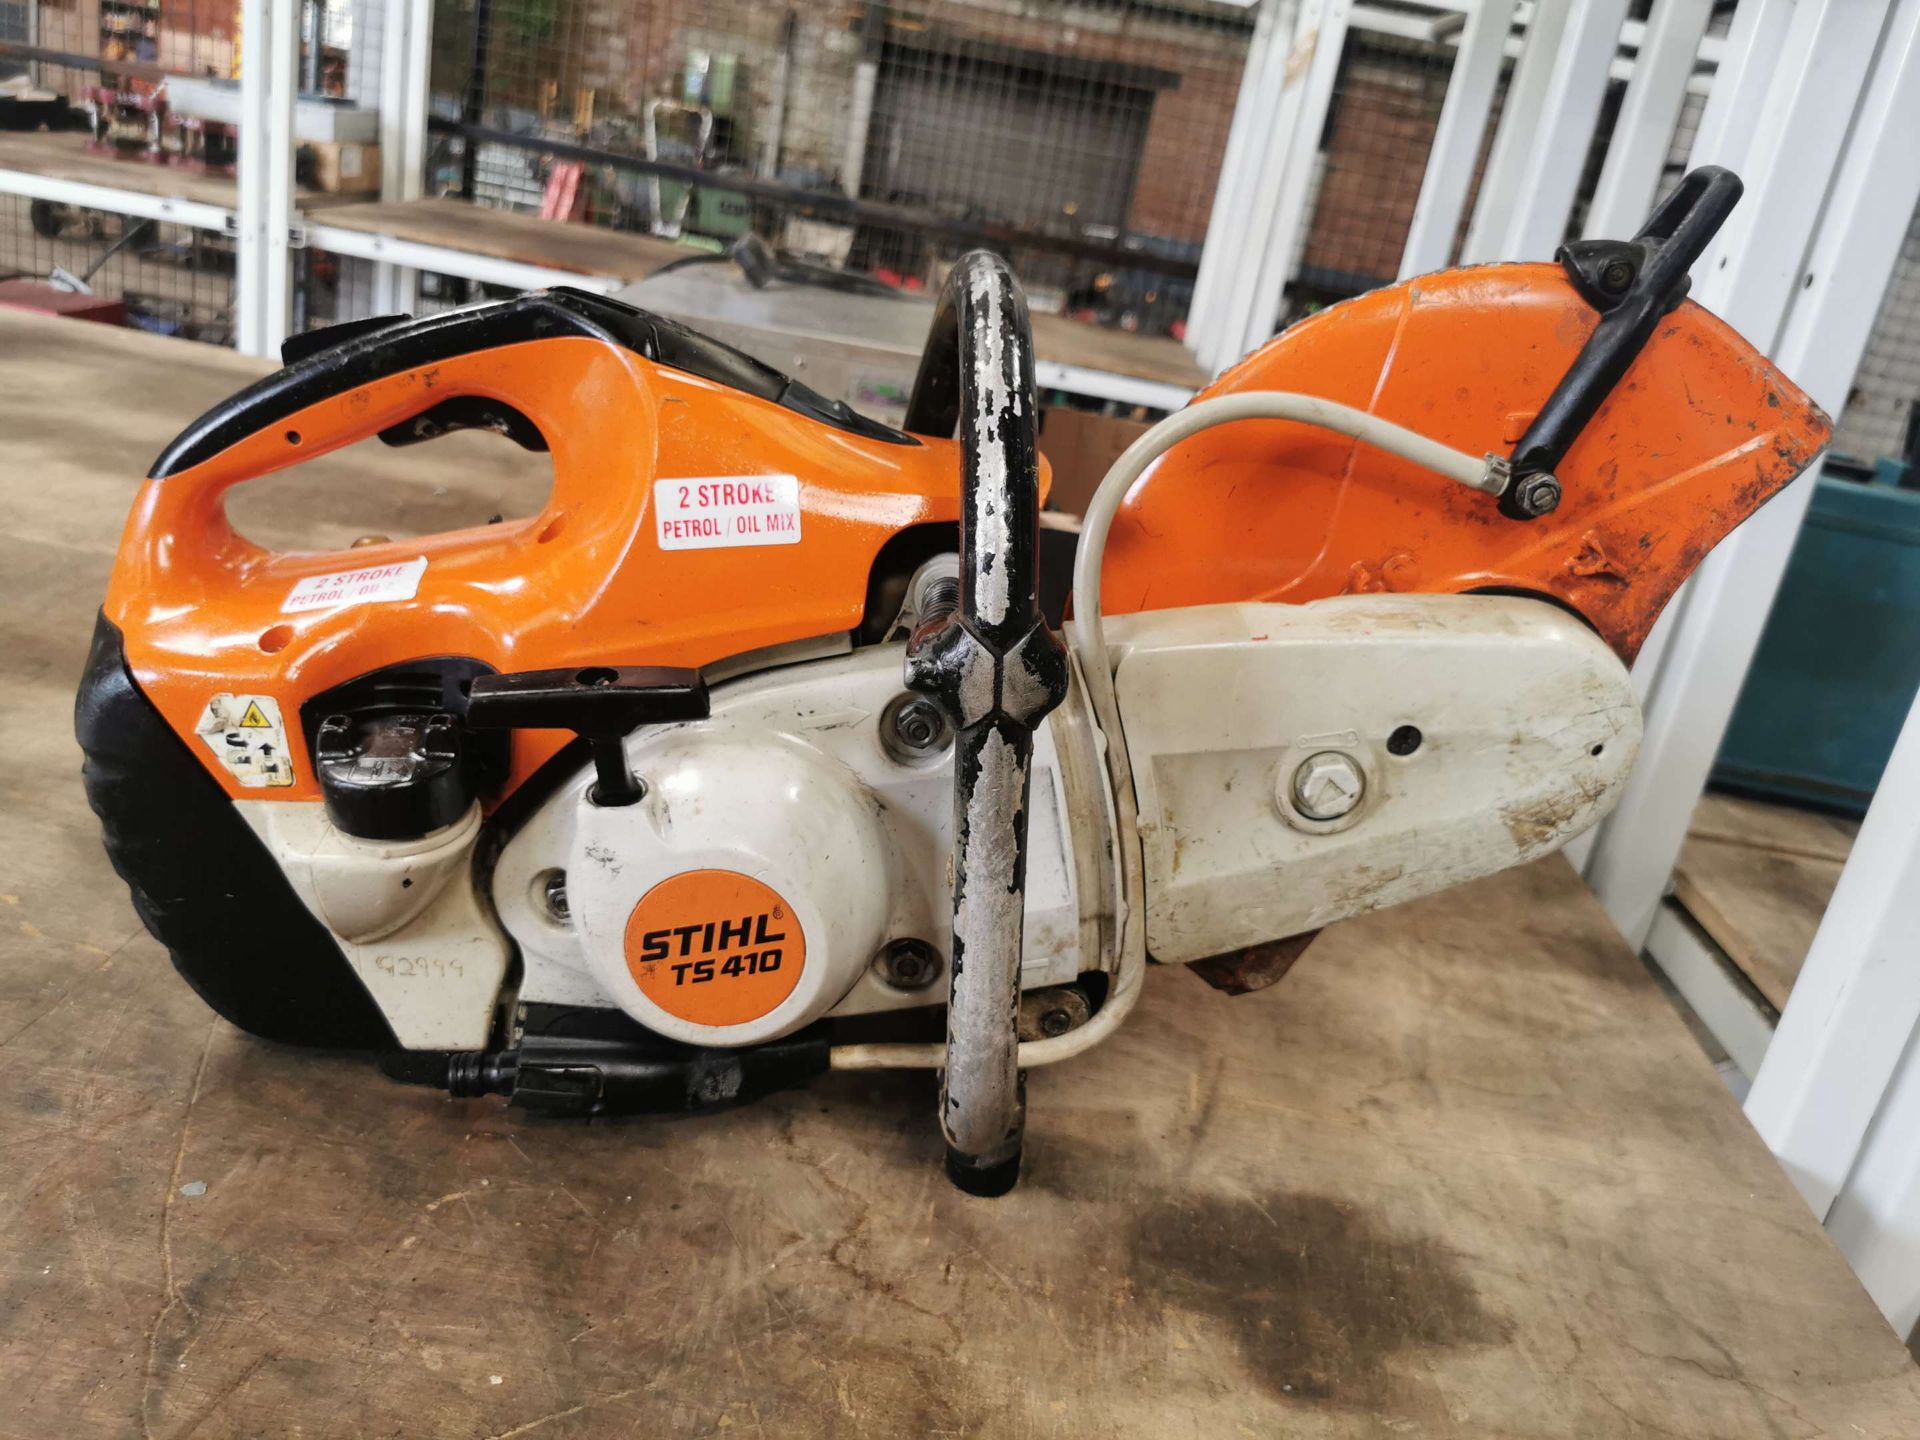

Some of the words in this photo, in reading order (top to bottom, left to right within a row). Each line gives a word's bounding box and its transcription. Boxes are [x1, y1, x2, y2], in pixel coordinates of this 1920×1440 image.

[679, 486, 690, 508] 2
[698, 483, 775, 507] STROKE
[663, 517, 722, 539] PETROL
[737, 515, 761, 534] OIL
[766, 513, 796, 532] MIX
[314, 578, 329, 589] 2
[333, 566, 405, 587] STROKE
[640, 914, 786, 962] STIHL
[670, 959, 716, 986] TS
[720, 948, 783, 977] 410
